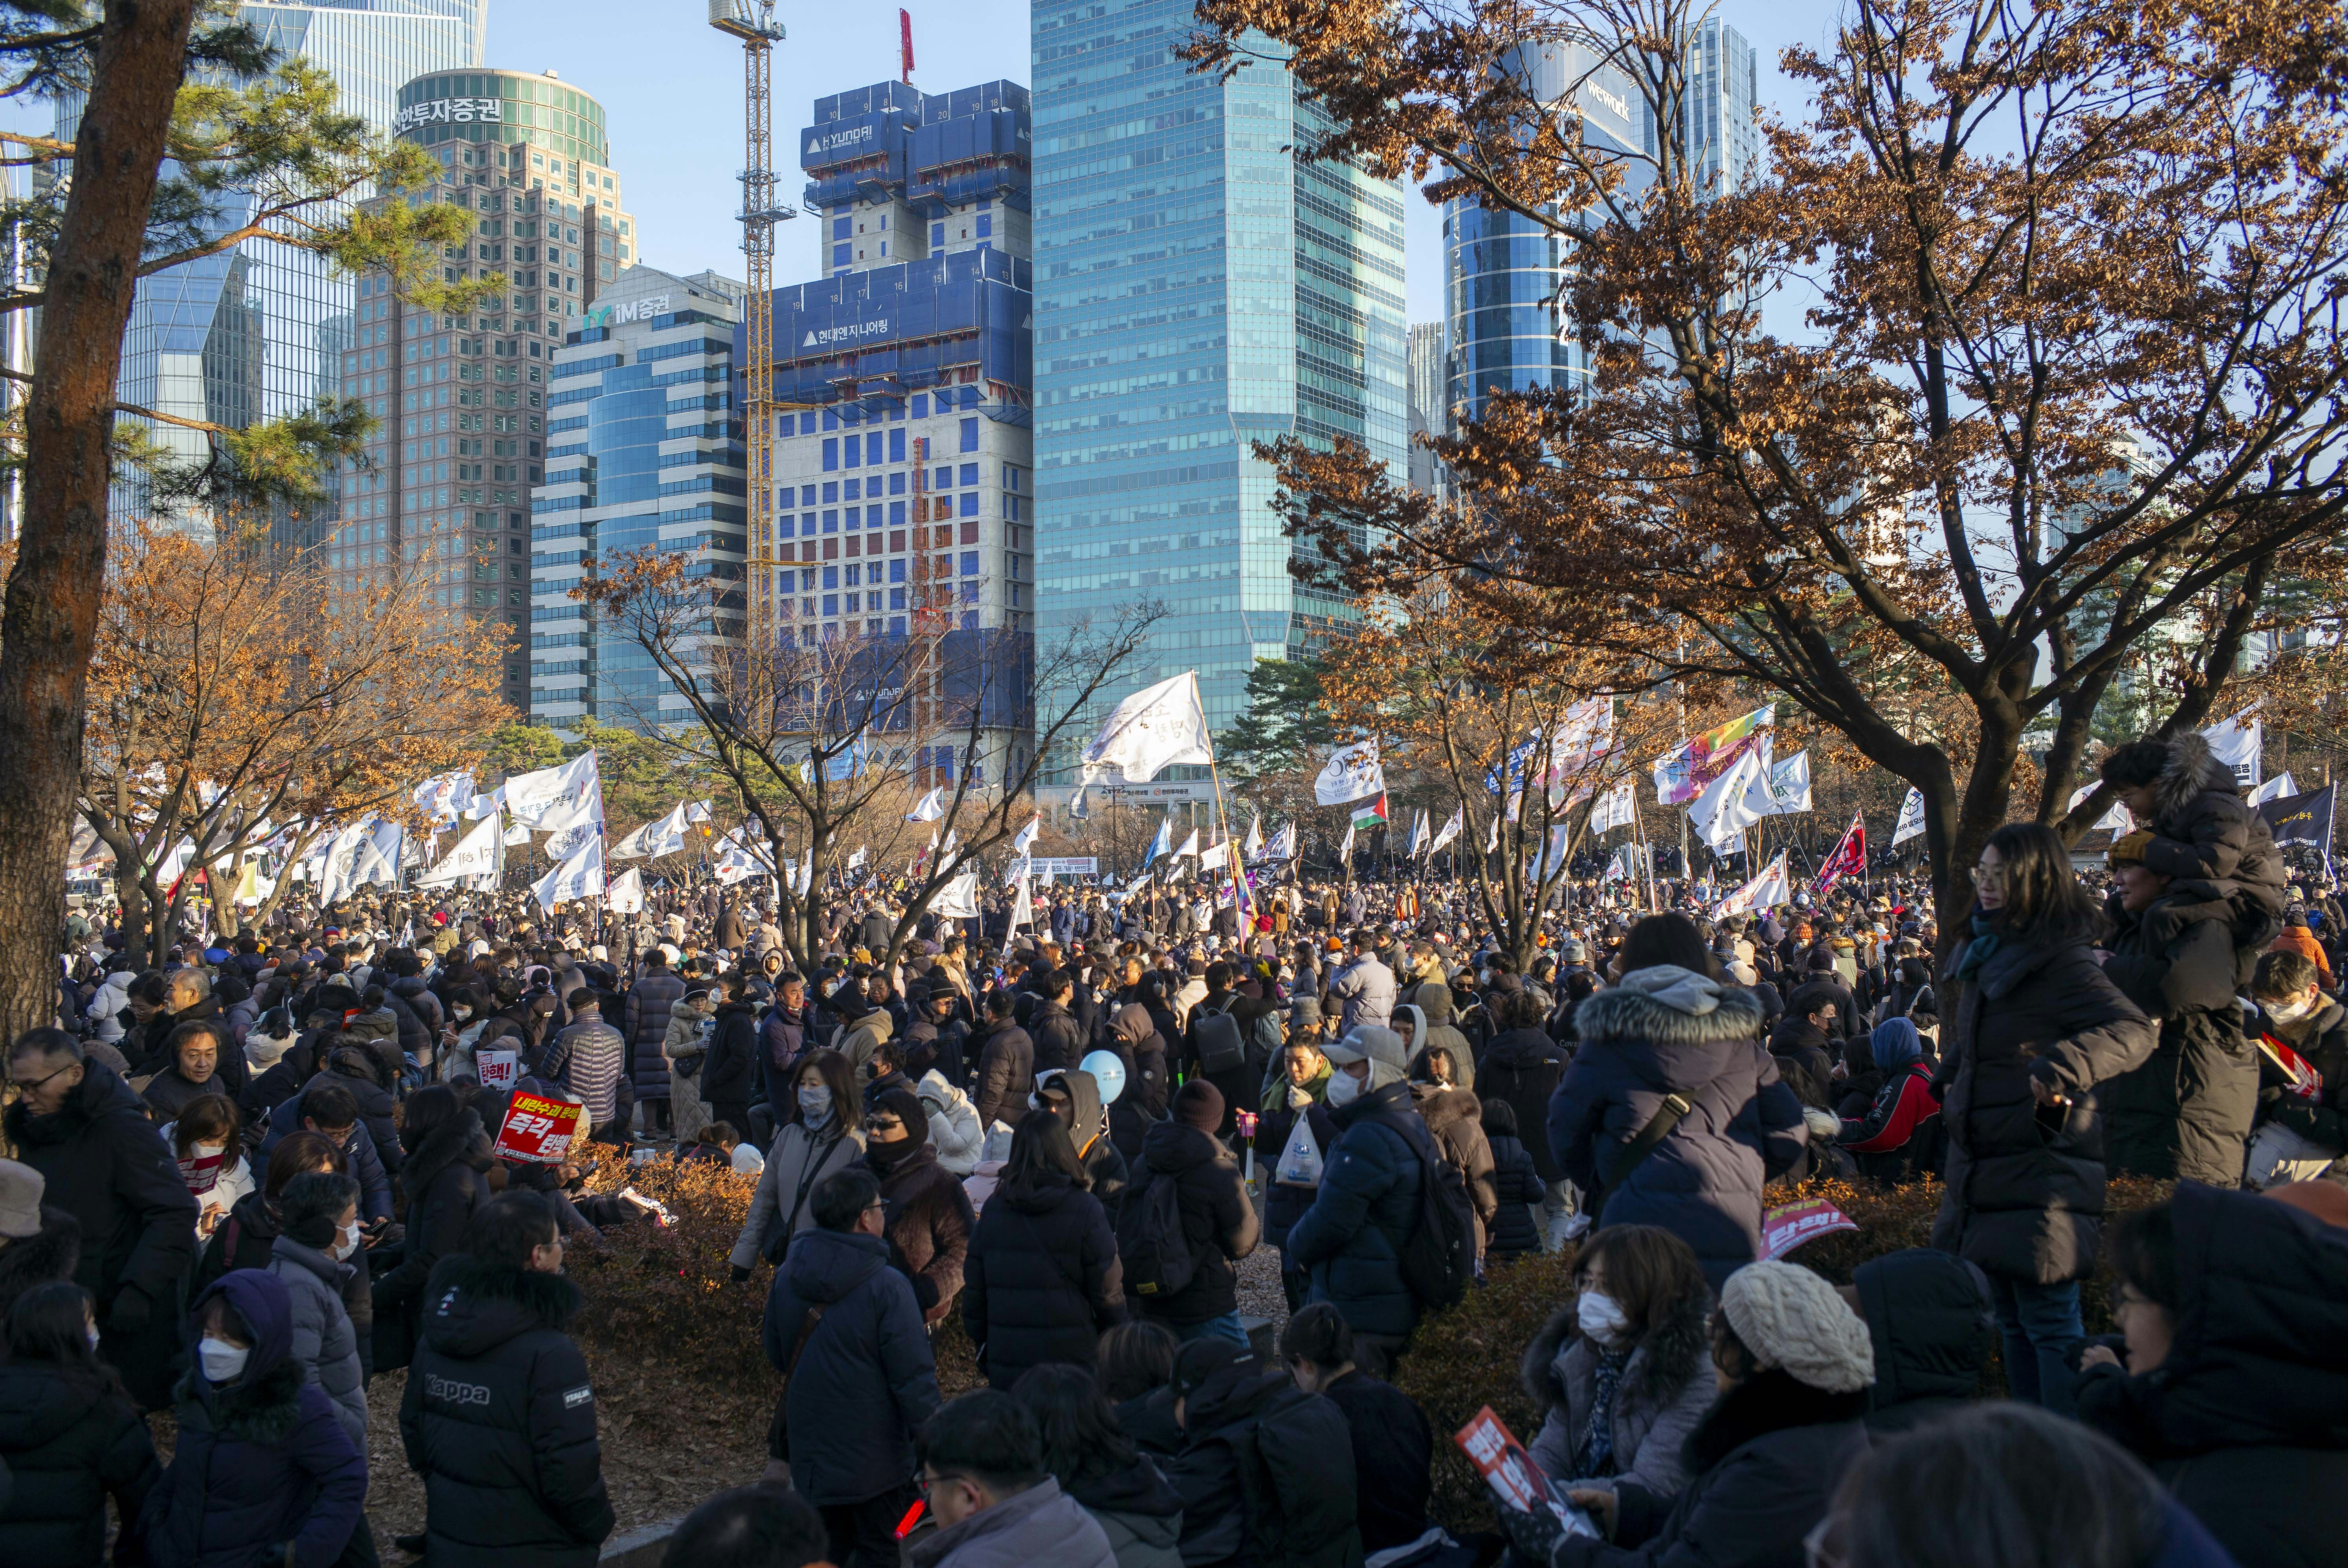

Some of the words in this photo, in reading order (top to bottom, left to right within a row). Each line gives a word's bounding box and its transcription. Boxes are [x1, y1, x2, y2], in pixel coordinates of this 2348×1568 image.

[990, 99, 998, 107] 18
[1585, 78, 1630, 123] wework
[972, 103, 980, 111] 19
[1022, 104, 1028, 113] 17
[938, 111, 947, 119] 20
[823, 125, 872, 147] HYUNDAI
[971, 267, 980, 275] 14
[1002, 270, 1009, 280] 13
[933, 275, 942, 283] 15
[895, 282, 903, 290] 16
[858, 289, 866, 298] 17
[830, 295, 838, 303] 18
[616, 294, 670, 324] iM증권
[792, 302, 800, 310] 19
[818, 319, 888, 344] 현대엔지니어링
[481, 1062, 511, 1084] 탄핵!
[513, 1096, 563, 1117] 내란수괴
[506, 1112, 554, 1139] 즉각
[1768, 1212, 1841, 1251] 탄핵!
[425, 1373, 490, 1405] Kappa
